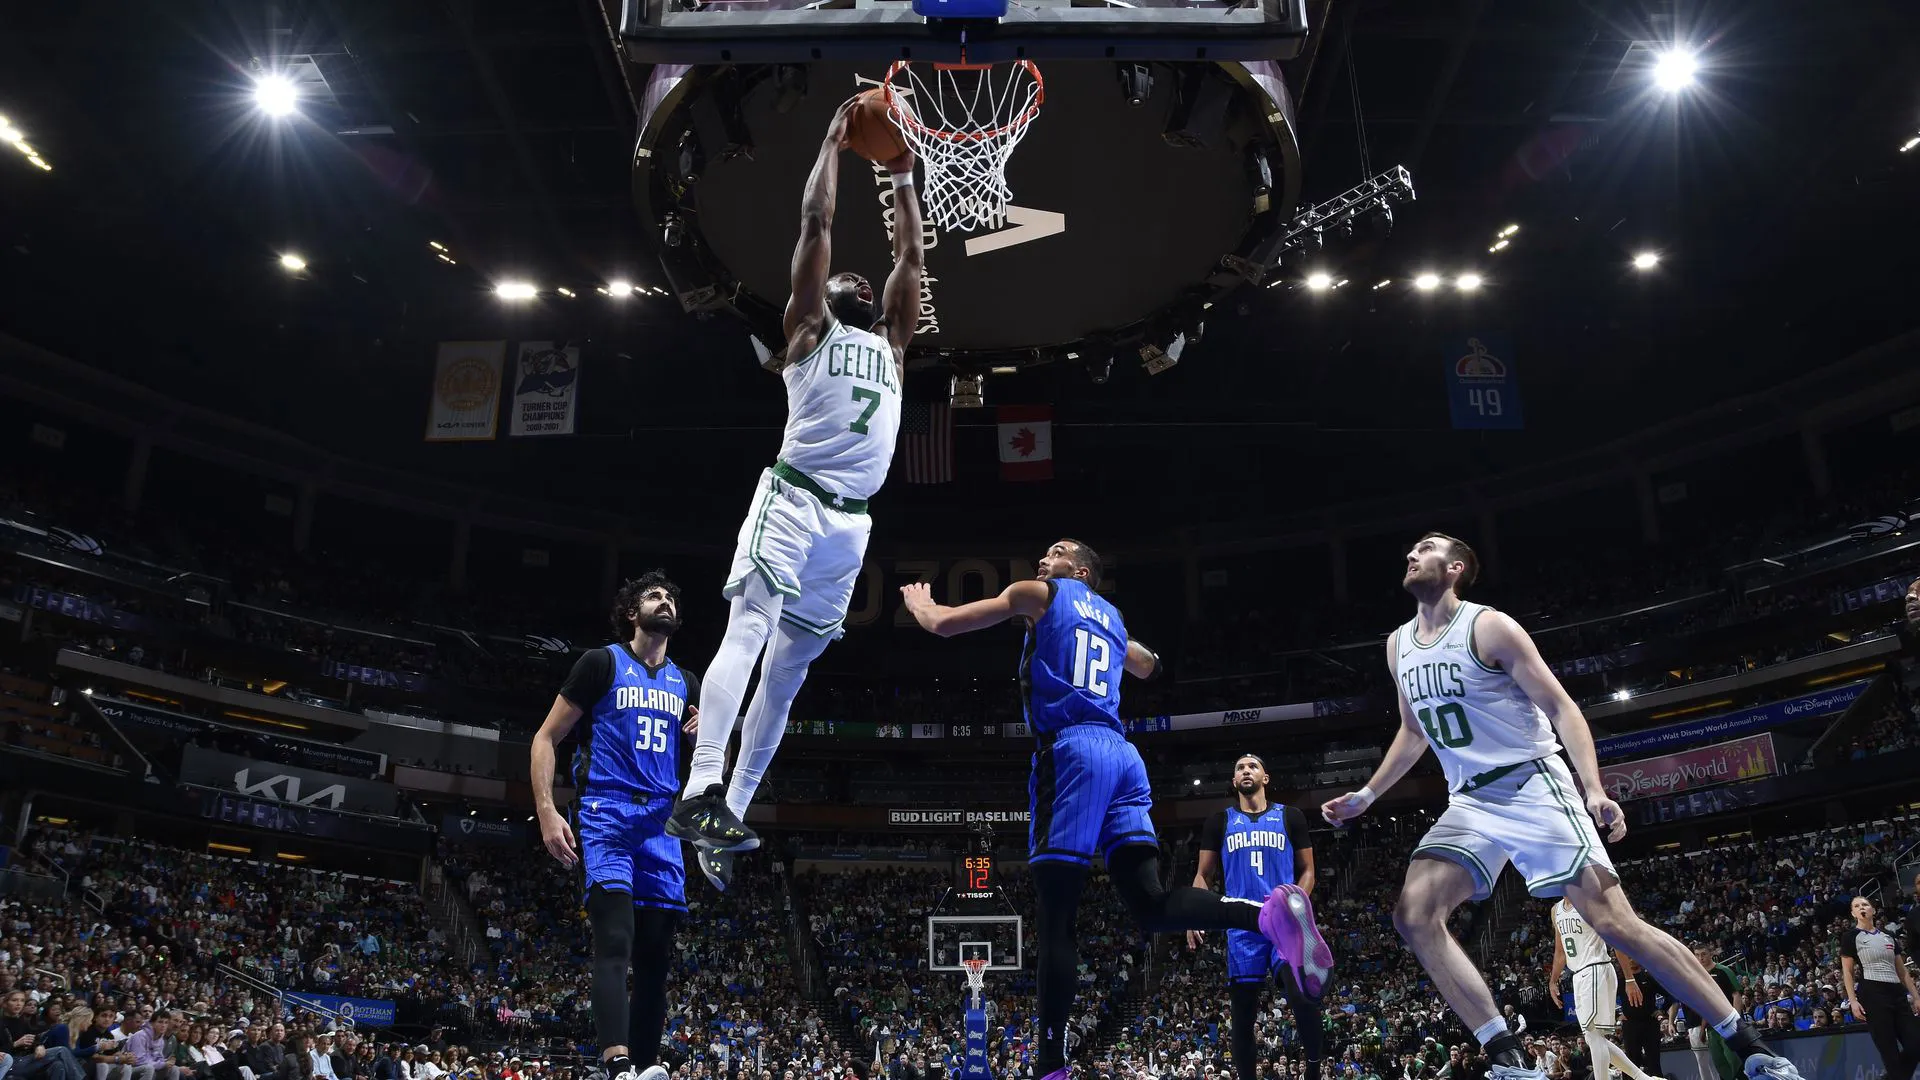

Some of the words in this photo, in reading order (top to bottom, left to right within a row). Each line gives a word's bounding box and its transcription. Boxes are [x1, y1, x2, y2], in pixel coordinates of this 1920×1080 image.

[828, 343, 897, 395] CELTICS
[523, 402, 551, 412] TURNER
[553, 401, 568, 411] CUP
[850, 386, 881, 435] 7
[1468, 389, 1502, 416] 49
[522, 411, 565, 422] CHAMPIONS
[1073, 600, 1110, 630] QUEEN
[1073, 628, 1110, 697] 12
[1401, 662, 1466, 705] CELTICS
[616, 686, 684, 721] ORLANDO
[1128, 720, 1135, 732] 4
[1161, 718, 1167, 731] 4
[1222, 710, 1261, 722] MASSEY
[635, 716, 668, 753] 35
[829, 723, 834, 735] 5
[952, 725, 971, 737] 6:35
[983, 725, 996, 735] 3RD
[1602, 743, 1613, 752] the
[1614, 739, 1641, 752] Holidays
[1642, 736, 1657, 745] with
[1662, 731, 1680, 742] Walt
[1681, 727, 1704, 739] Disney
[1705, 721, 1728, 733] World
[1729, 716, 1752, 729] Annual
[1753, 712, 1769, 723] Pass
[1600, 768, 1681, 797] Disney
[1677, 756, 1729, 782] World
[477, 821, 510, 832] FANDUEL
[891, 812, 920, 823] BUD
[921, 812, 962, 823] LIGHT
[966, 811, 1031, 822] BASELINE
[1227, 831, 1286, 854] ORLANDO
[965, 857, 991, 869] 6:35
[1250, 850, 1264, 876] 4
[969, 868, 989, 889] 12
[1564, 937, 1578, 958] 9
[354, 1006, 393, 1016] ROTHMAN
